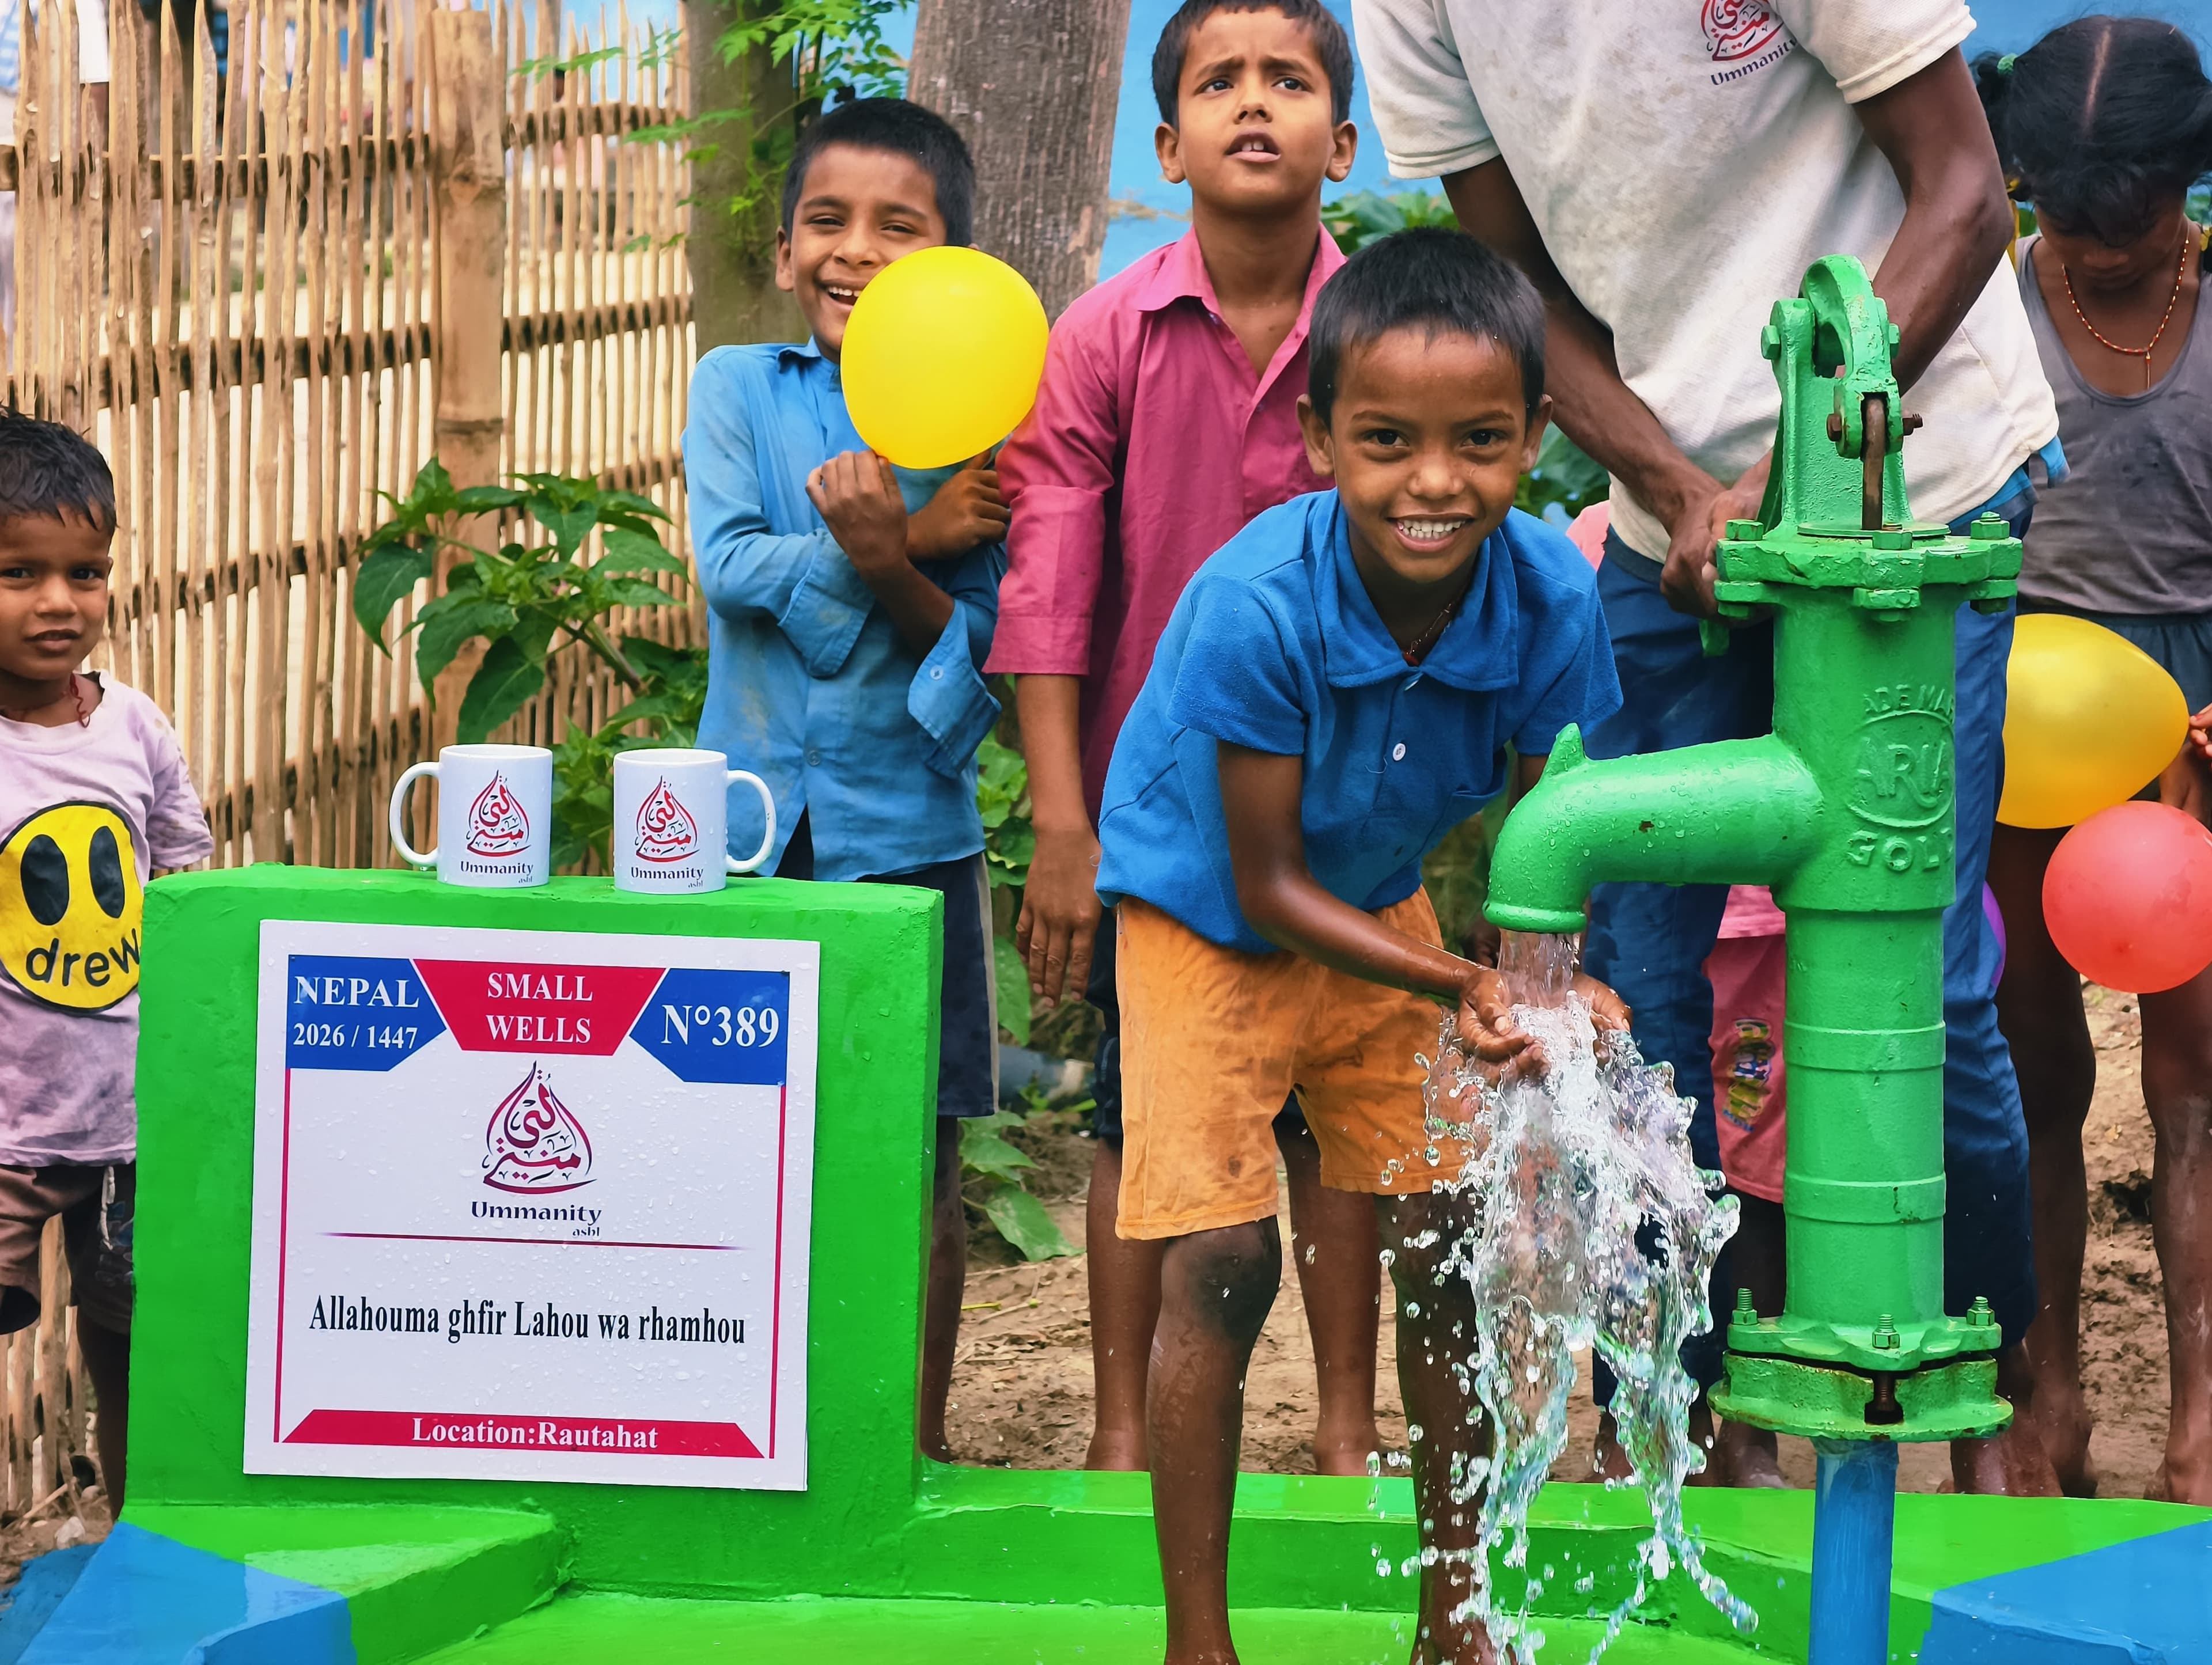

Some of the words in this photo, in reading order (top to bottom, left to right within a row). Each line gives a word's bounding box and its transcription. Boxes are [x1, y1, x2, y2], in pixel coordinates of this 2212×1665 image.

[460, 860, 533, 875] Ummanity
[631, 866, 703, 881] Ummanity
[26, 928, 140, 987] drew
[294, 977, 419, 1009] NEPAL
[487, 972, 593, 1002] SMALL
[293, 1023, 345, 1046] 2026
[351, 1026, 361, 1048] /
[366, 1025, 418, 1050] 1447
[486, 1014, 592, 1044] WELLS
[471, 1201, 602, 1226] Ummanity
[573, 1227, 600, 1237] asbl
[309, 1295, 440, 1333] Allahouma
[448, 1299, 507, 1344] ghfir
[513, 1301, 589, 1339] Lahou
[597, 1314, 630, 1340] wa
[638, 1305, 746, 1344] rhamhou
